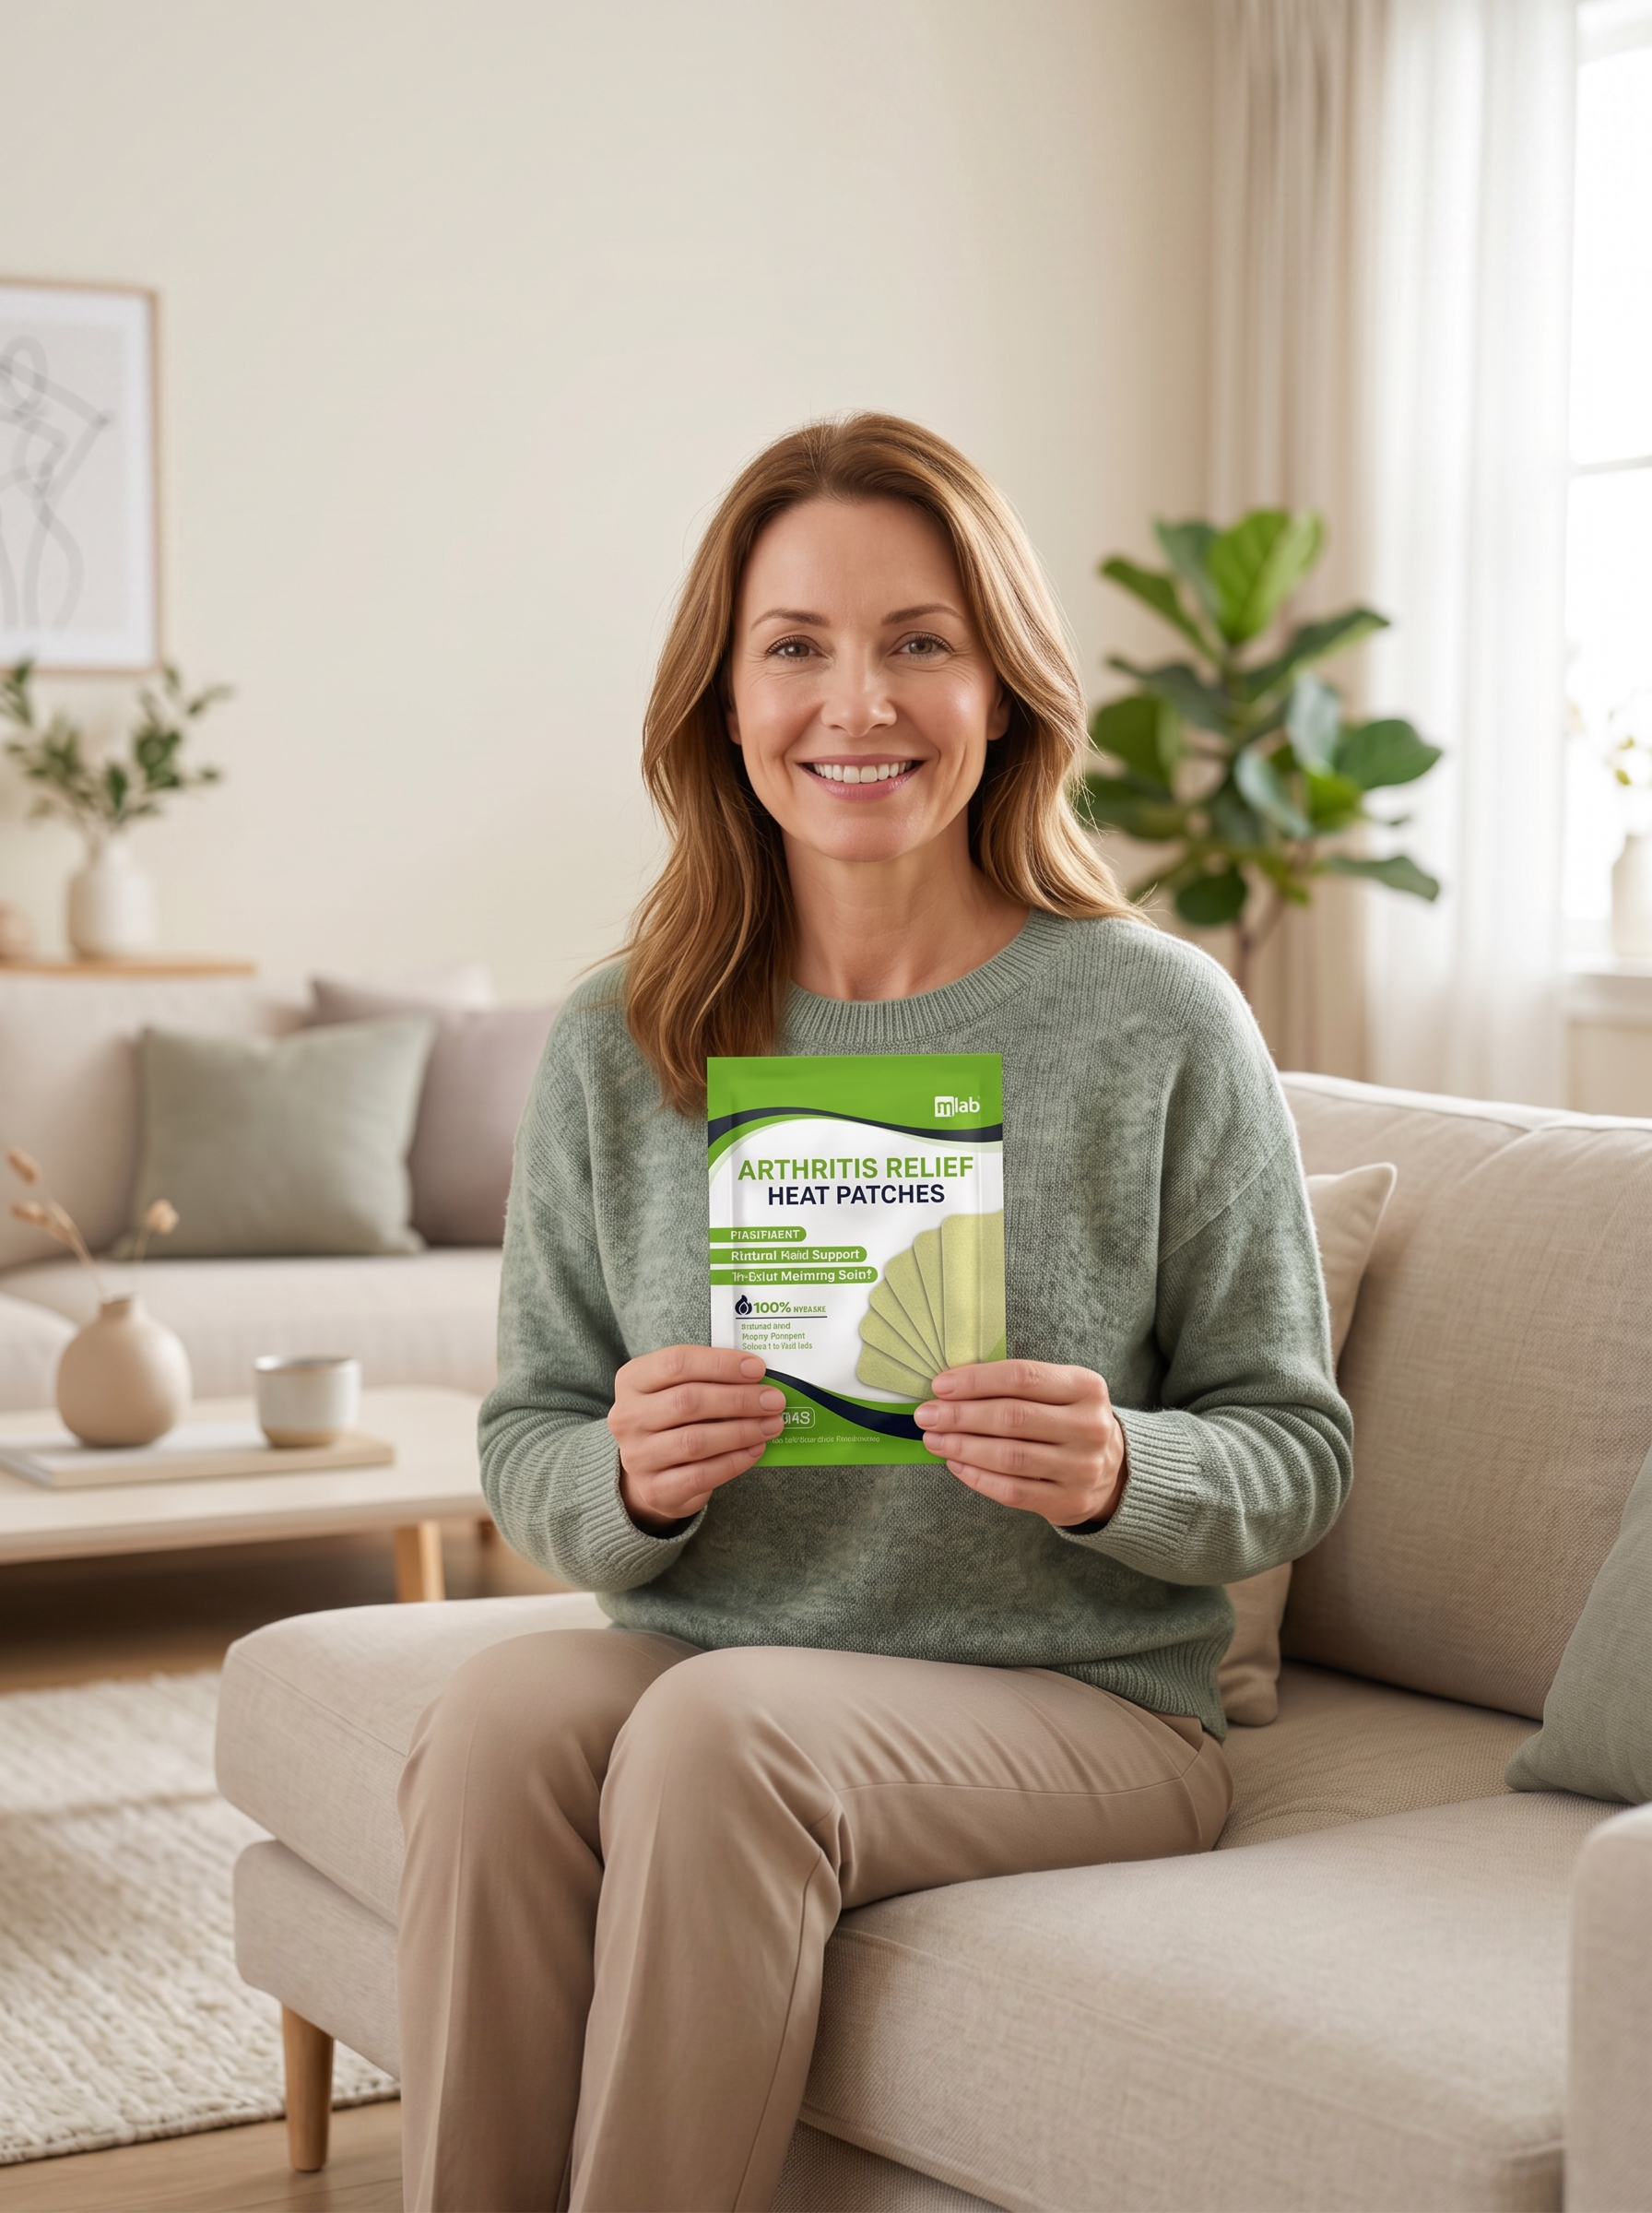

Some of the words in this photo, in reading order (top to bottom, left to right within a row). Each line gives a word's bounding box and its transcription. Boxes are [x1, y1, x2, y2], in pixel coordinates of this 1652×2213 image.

[738, 1157, 878, 1180] ARTHRITIS
[887, 1156, 974, 1178] RELIEF
[768, 1186, 830, 1205] HEAT
[836, 1184, 945, 1205] PATCHES
[812, 1249, 859, 1261] Support
[753, 1301, 791, 1314] 100%
